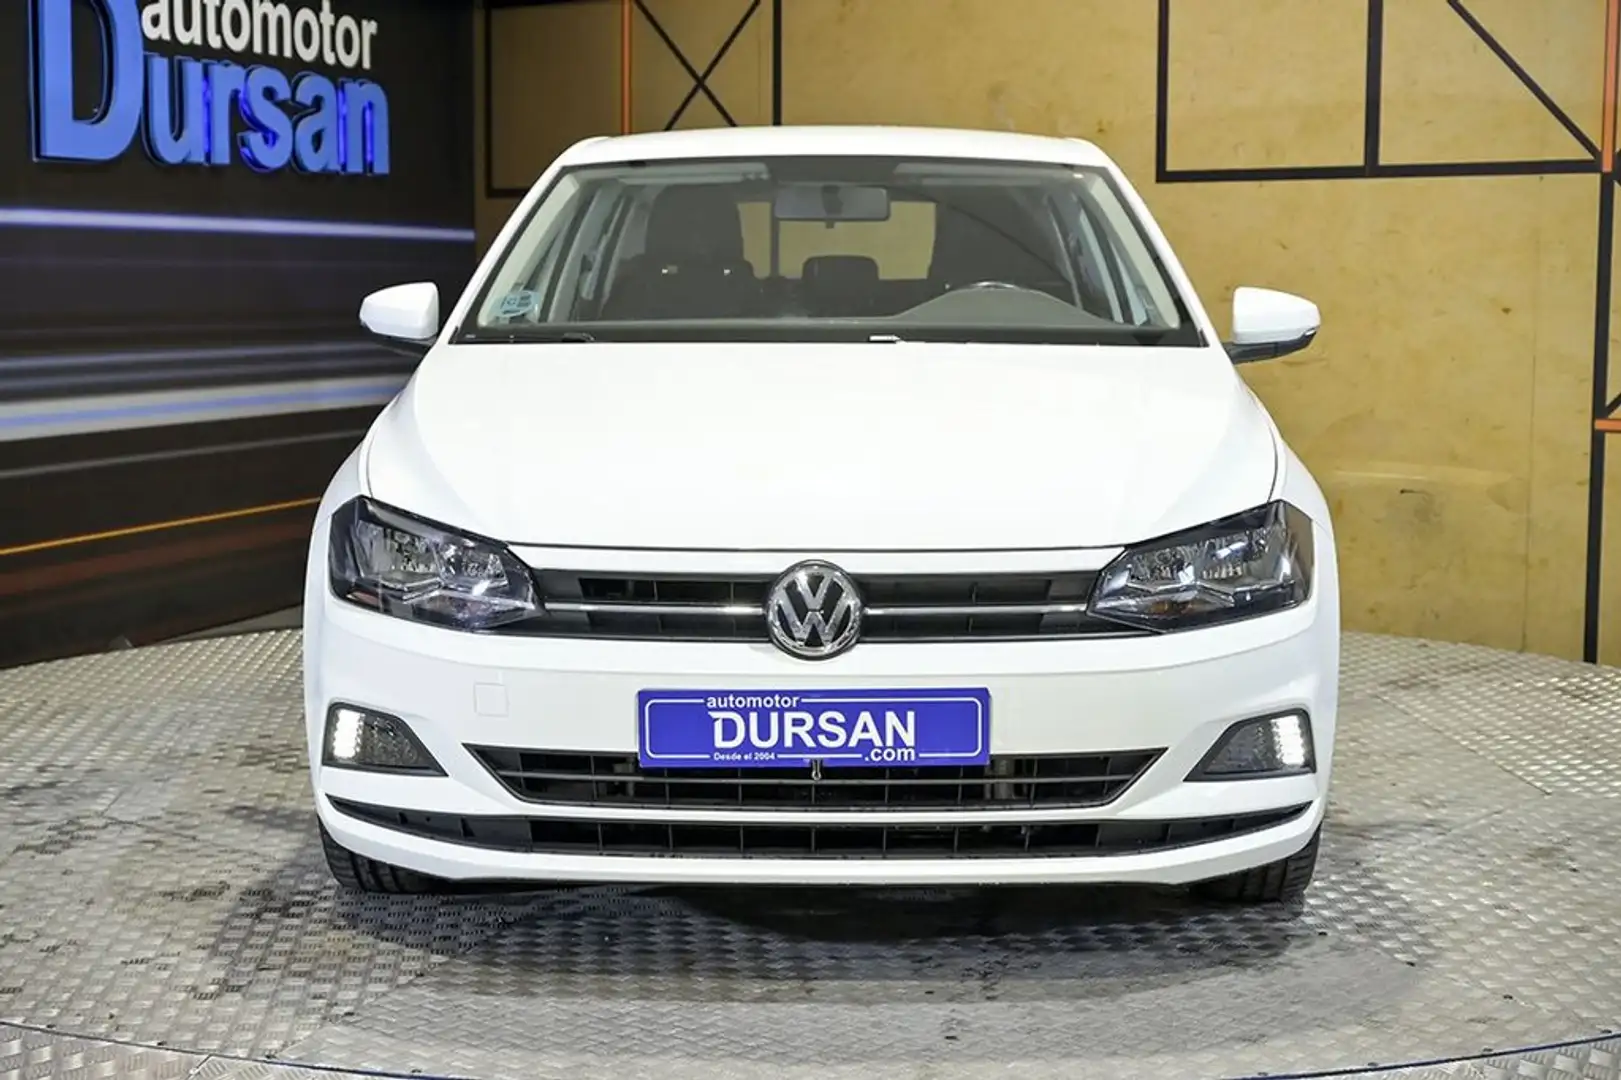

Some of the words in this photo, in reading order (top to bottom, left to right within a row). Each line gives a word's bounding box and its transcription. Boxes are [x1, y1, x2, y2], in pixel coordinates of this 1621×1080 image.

[141, 0, 378, 70] automotor
[30, 0, 390, 175] Dursan
[771, 564, 858, 654] VW
[706, 694, 800, 708] automotor
[707, 710, 916, 749] DURSAN
[864, 747, 916, 762] .com
